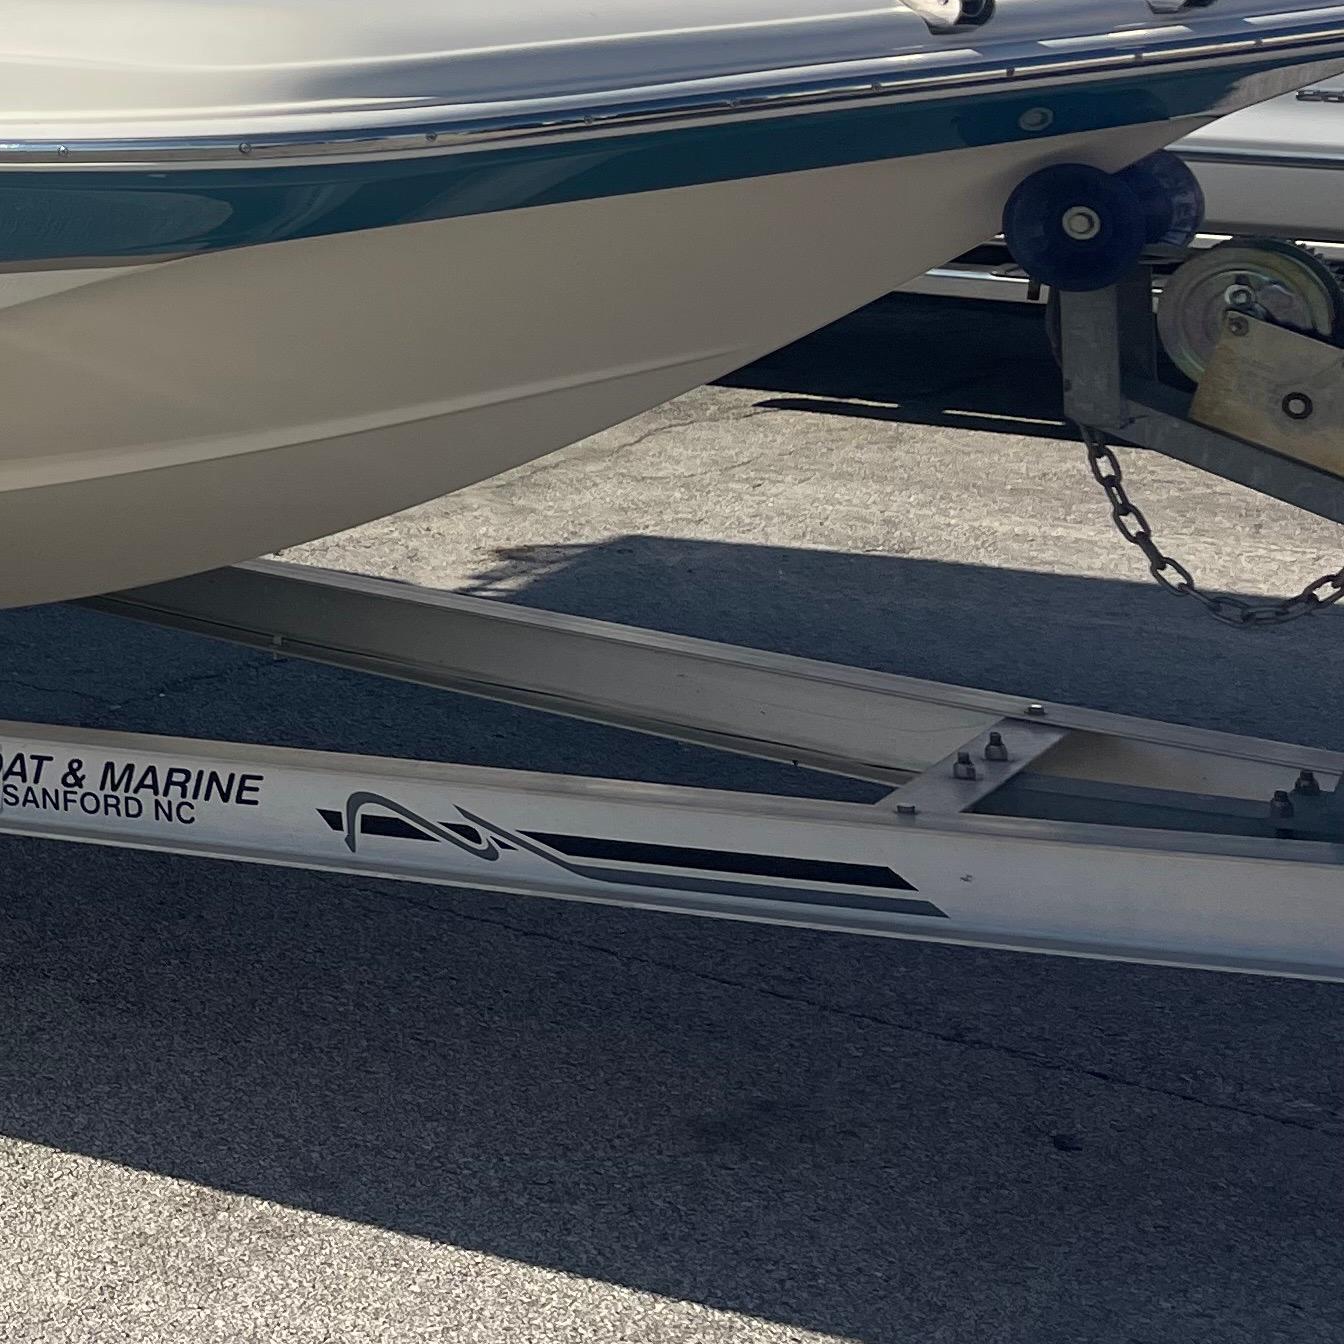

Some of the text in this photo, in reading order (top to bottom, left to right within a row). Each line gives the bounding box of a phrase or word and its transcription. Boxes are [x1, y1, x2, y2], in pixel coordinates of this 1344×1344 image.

[0, 783, 143, 819] SANFORD
[154, 798, 196, 825] NC
[60, 758, 86, 790] &
[99, 760, 264, 806] MARINE
